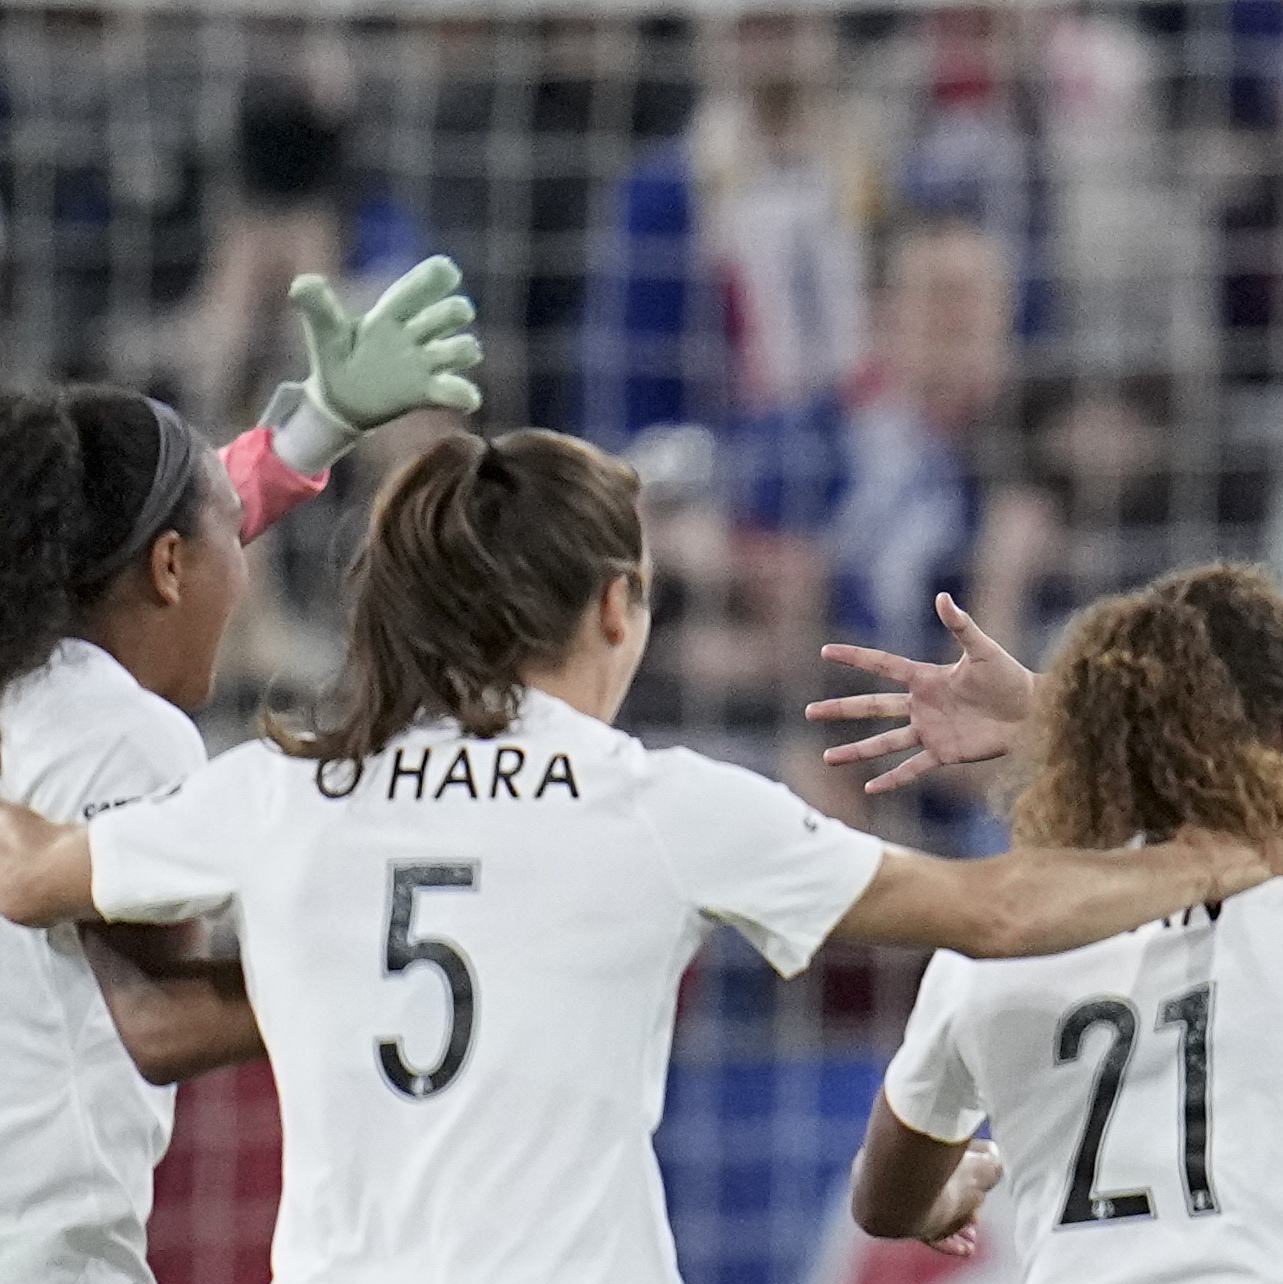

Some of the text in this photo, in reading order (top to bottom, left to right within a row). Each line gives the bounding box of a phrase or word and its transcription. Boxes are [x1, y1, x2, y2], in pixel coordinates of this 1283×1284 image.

[316, 746, 580, 800] OHARA
[374, 858, 482, 1102] 5
[1054, 980, 1221, 1232] 21
